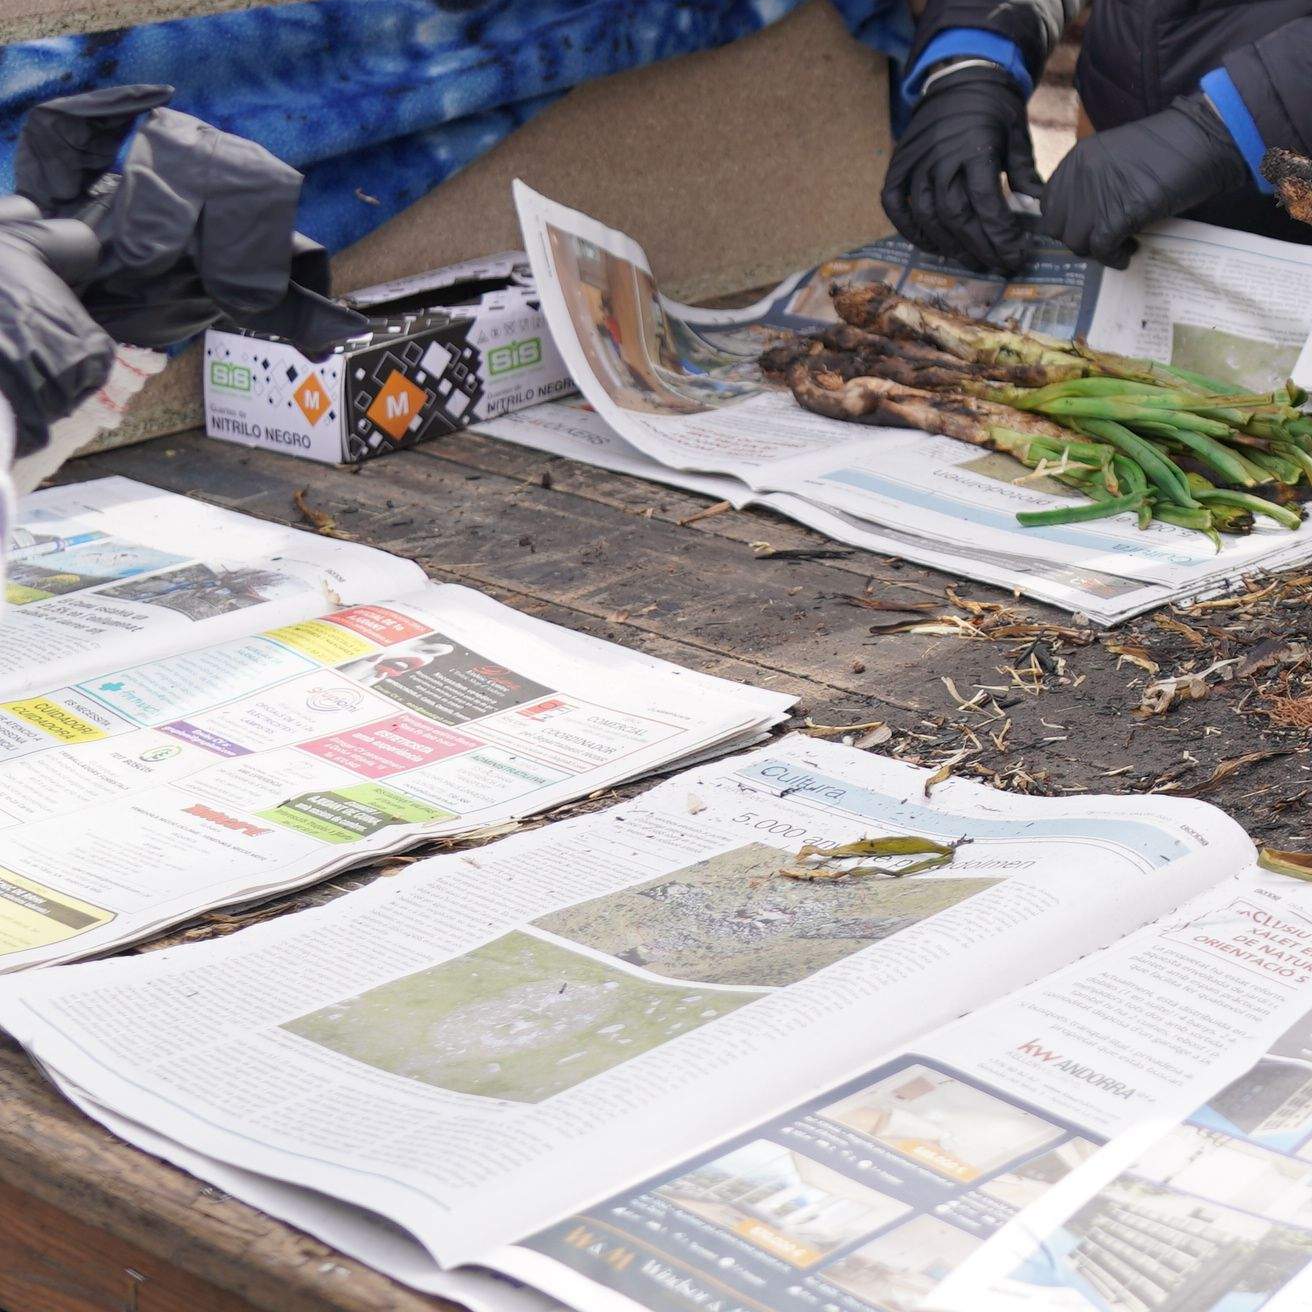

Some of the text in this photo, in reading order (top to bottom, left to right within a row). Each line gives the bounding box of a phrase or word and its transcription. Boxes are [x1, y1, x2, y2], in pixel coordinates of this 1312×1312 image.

[305, 391, 320, 409] M
[385, 393, 409, 417] M
[487, 389, 535, 414] NITRILO
[210, 416, 311, 448] NITRILO NEGRO
[537, 727, 620, 755] COORDINADOR
[759, 764, 848, 802] Cultura
[732, 812, 808, 840] 5.000
[1231, 934, 1259, 947] DE
[1191, 932, 1298, 978] ORIENTACIÓ
[1015, 1036, 1139, 1100] kw ANDORRA
